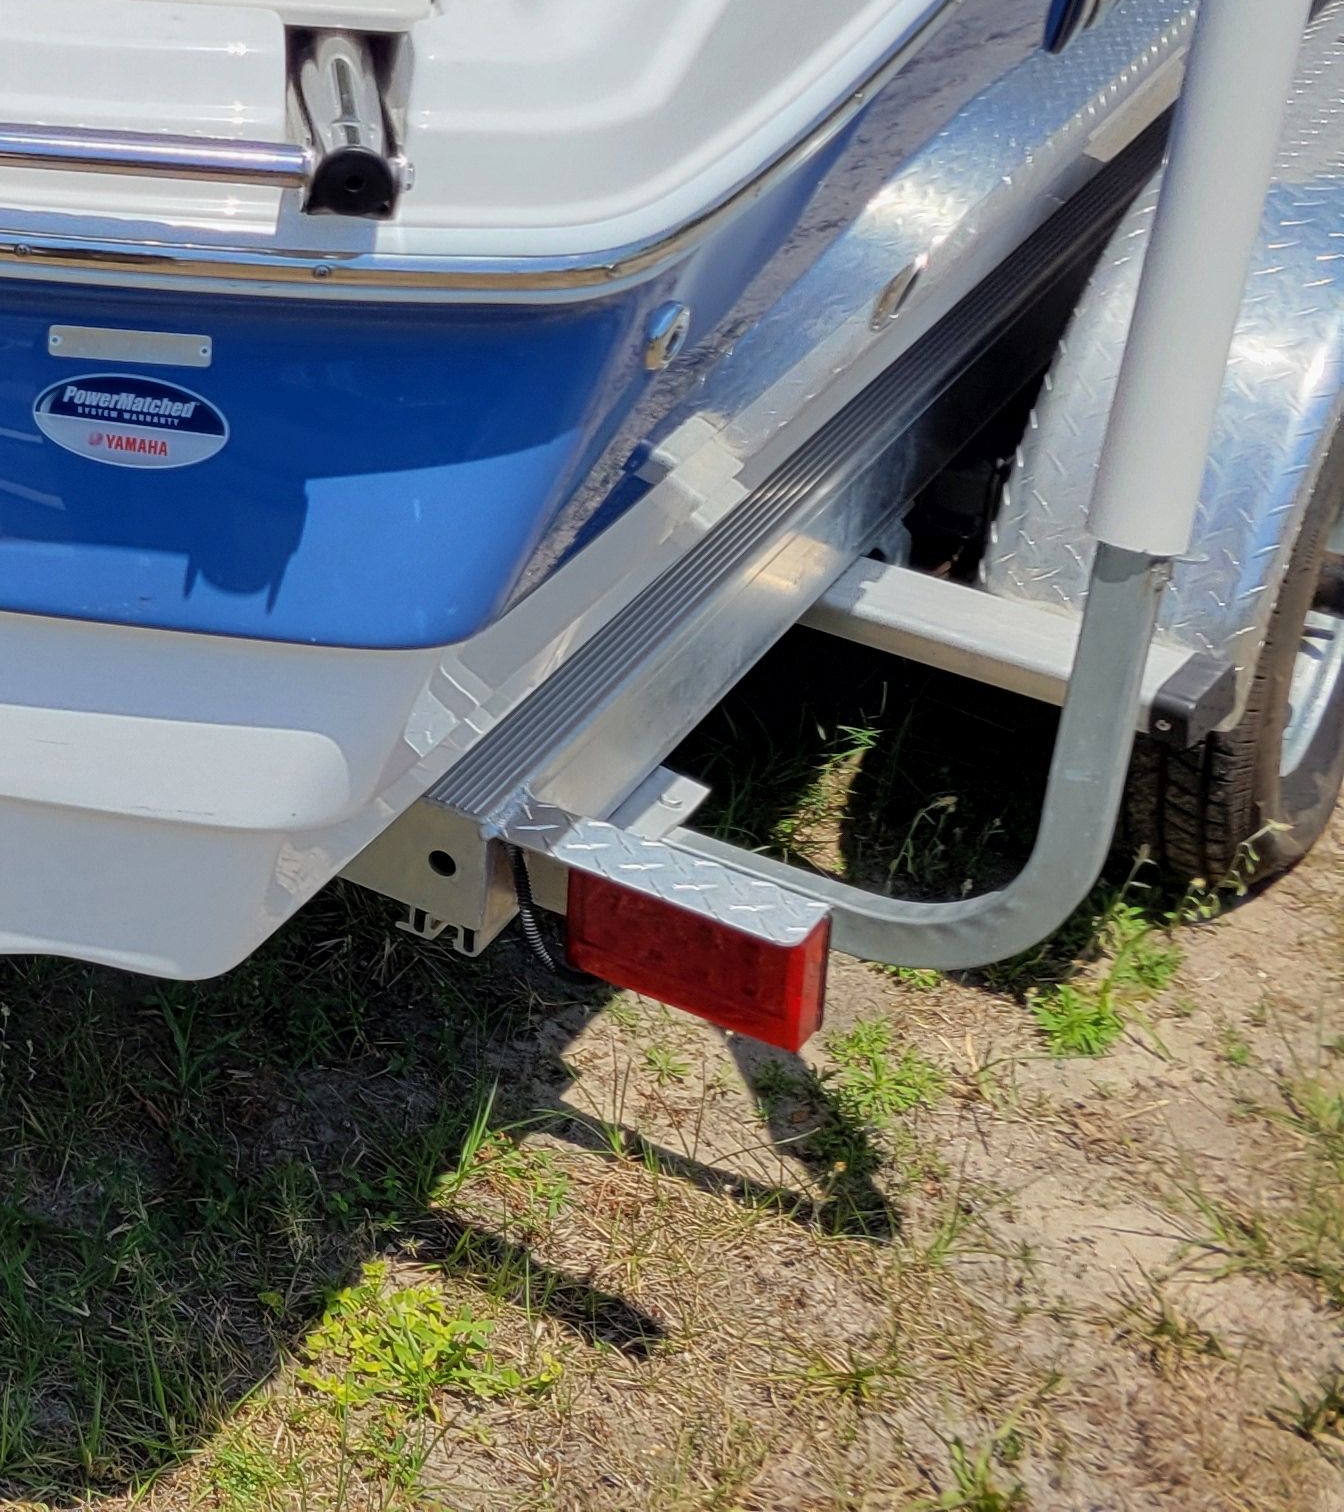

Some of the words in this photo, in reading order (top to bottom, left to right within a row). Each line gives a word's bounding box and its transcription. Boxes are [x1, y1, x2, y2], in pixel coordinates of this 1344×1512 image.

[62, 385, 196, 418] PowerMatched
[77, 405, 118, 418] SYSTEM
[123, 411, 180, 426] WARRANTY
[106, 433, 168, 457] YAMAHA
